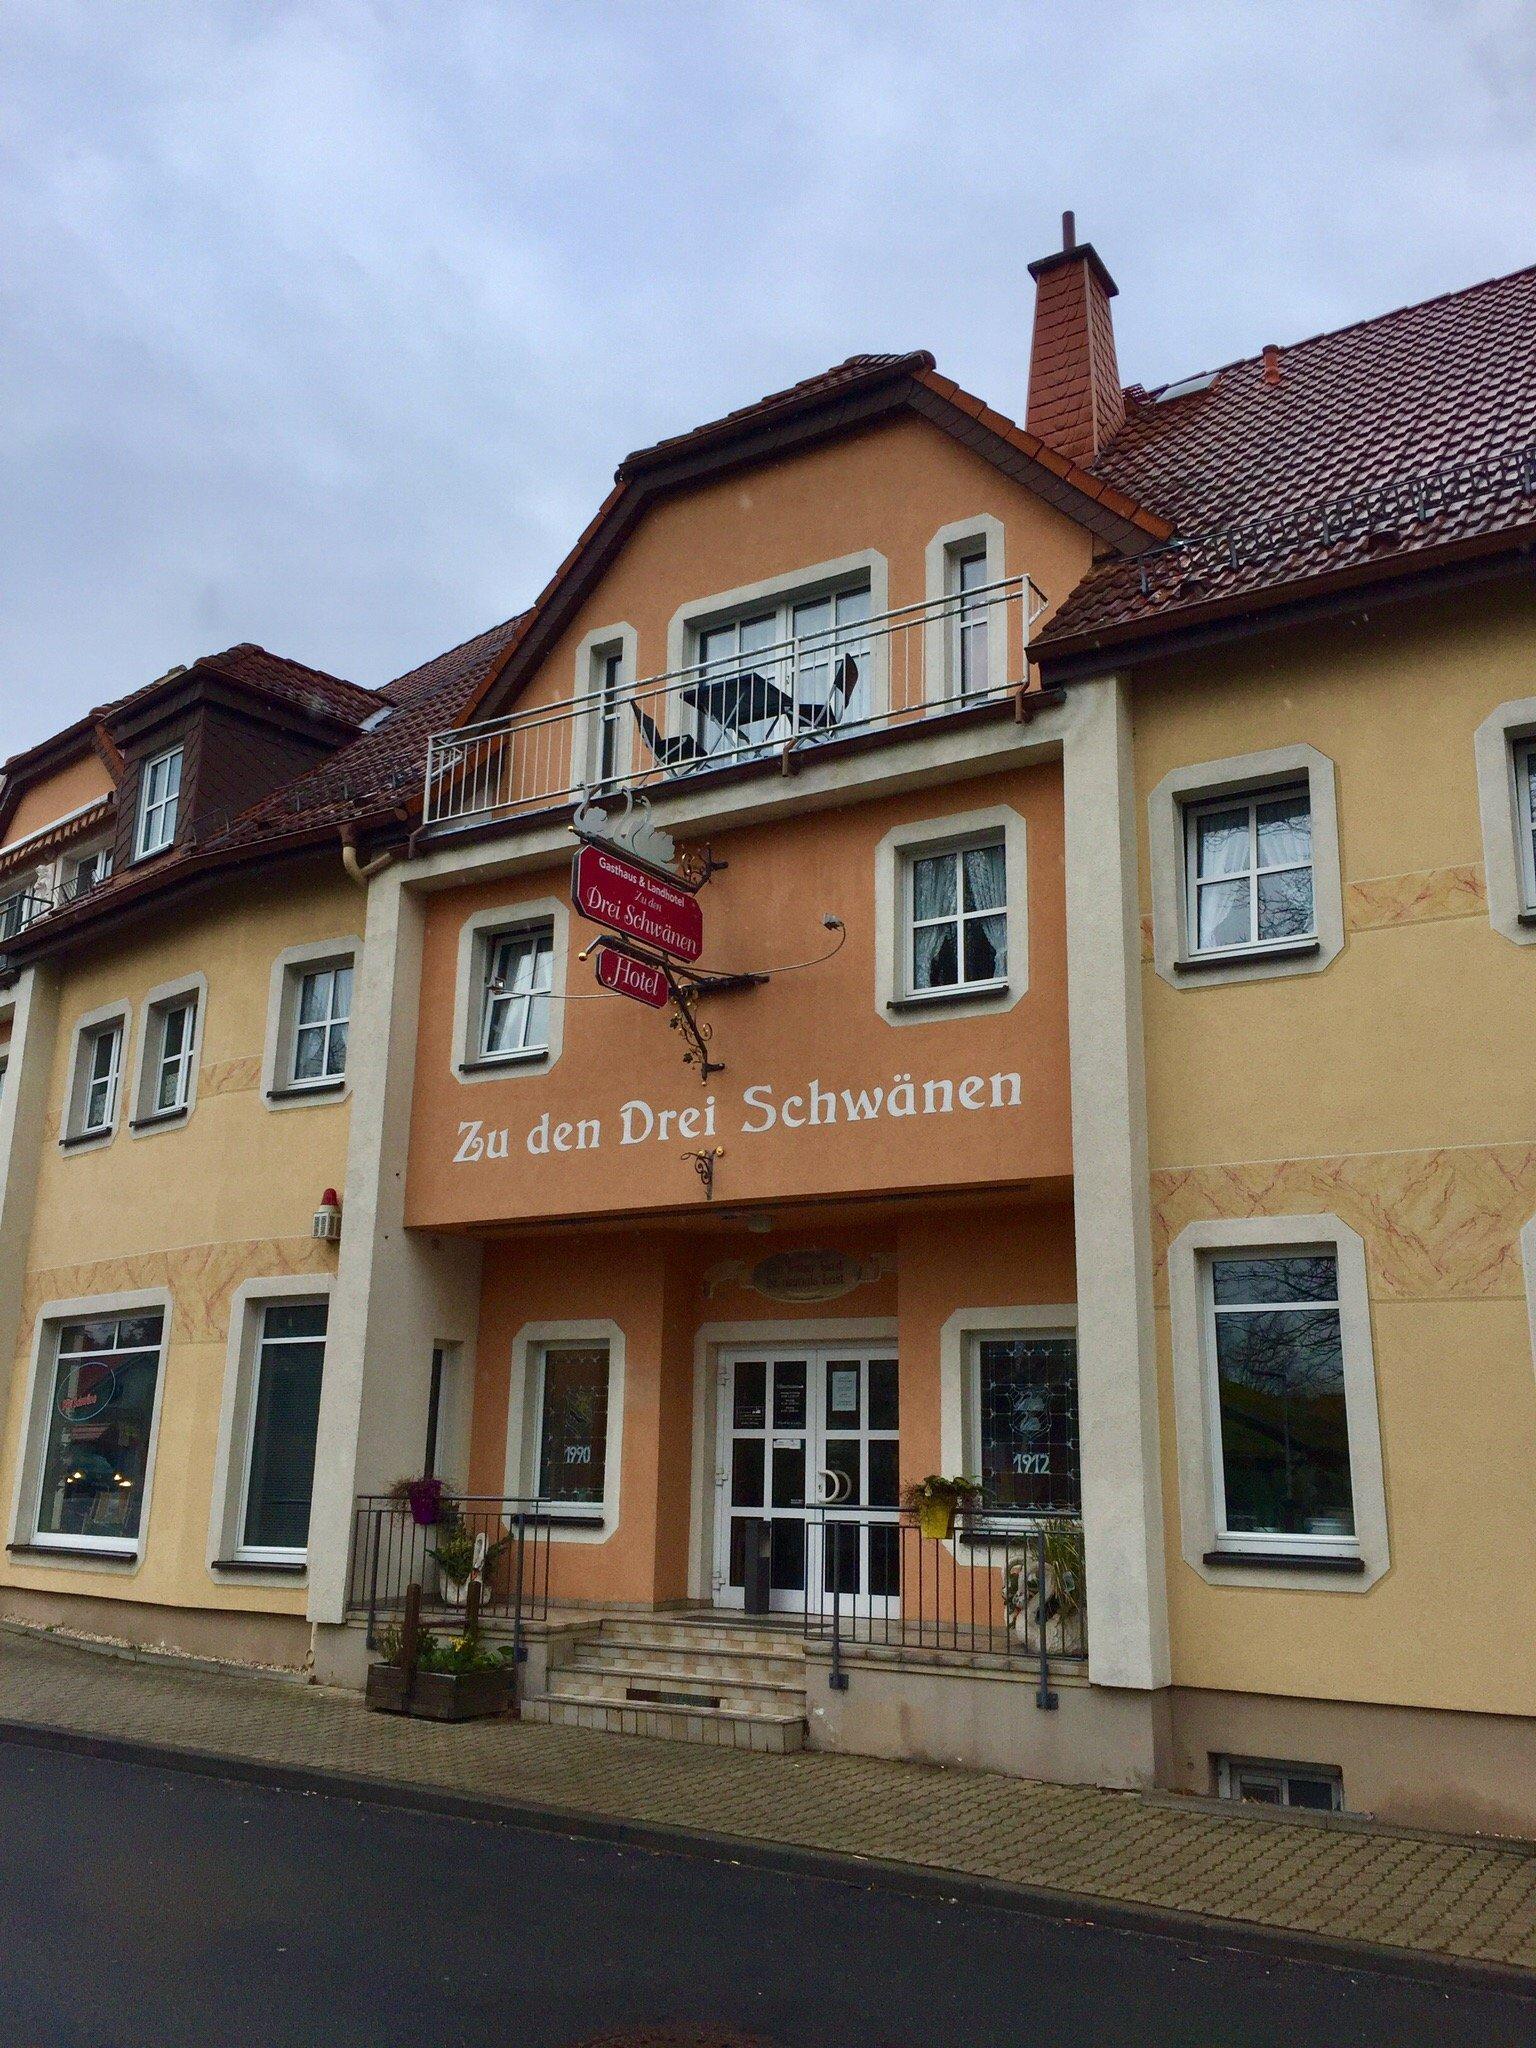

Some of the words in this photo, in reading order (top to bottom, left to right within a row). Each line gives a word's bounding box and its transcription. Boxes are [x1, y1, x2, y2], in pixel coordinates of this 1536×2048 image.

[599, 856, 637, 884] Gasthaus
[638, 876, 646, 889] &
[647, 880, 685, 907] Landhotel
[634, 890, 647, 905] Zu
[586, 885, 621, 921] Drei
[624, 904, 697, 955] Schwänen
[607, 956, 659, 996] Hotel
[452, 1120, 509, 1163] Zu
[527, 1113, 601, 1156] den
[619, 1094, 717, 1145] Drei
[741, 1072, 1023, 1134] Schwänen
[563, 1446, 591, 1464] 1990
[1012, 1453, 1051, 1474] 1912
